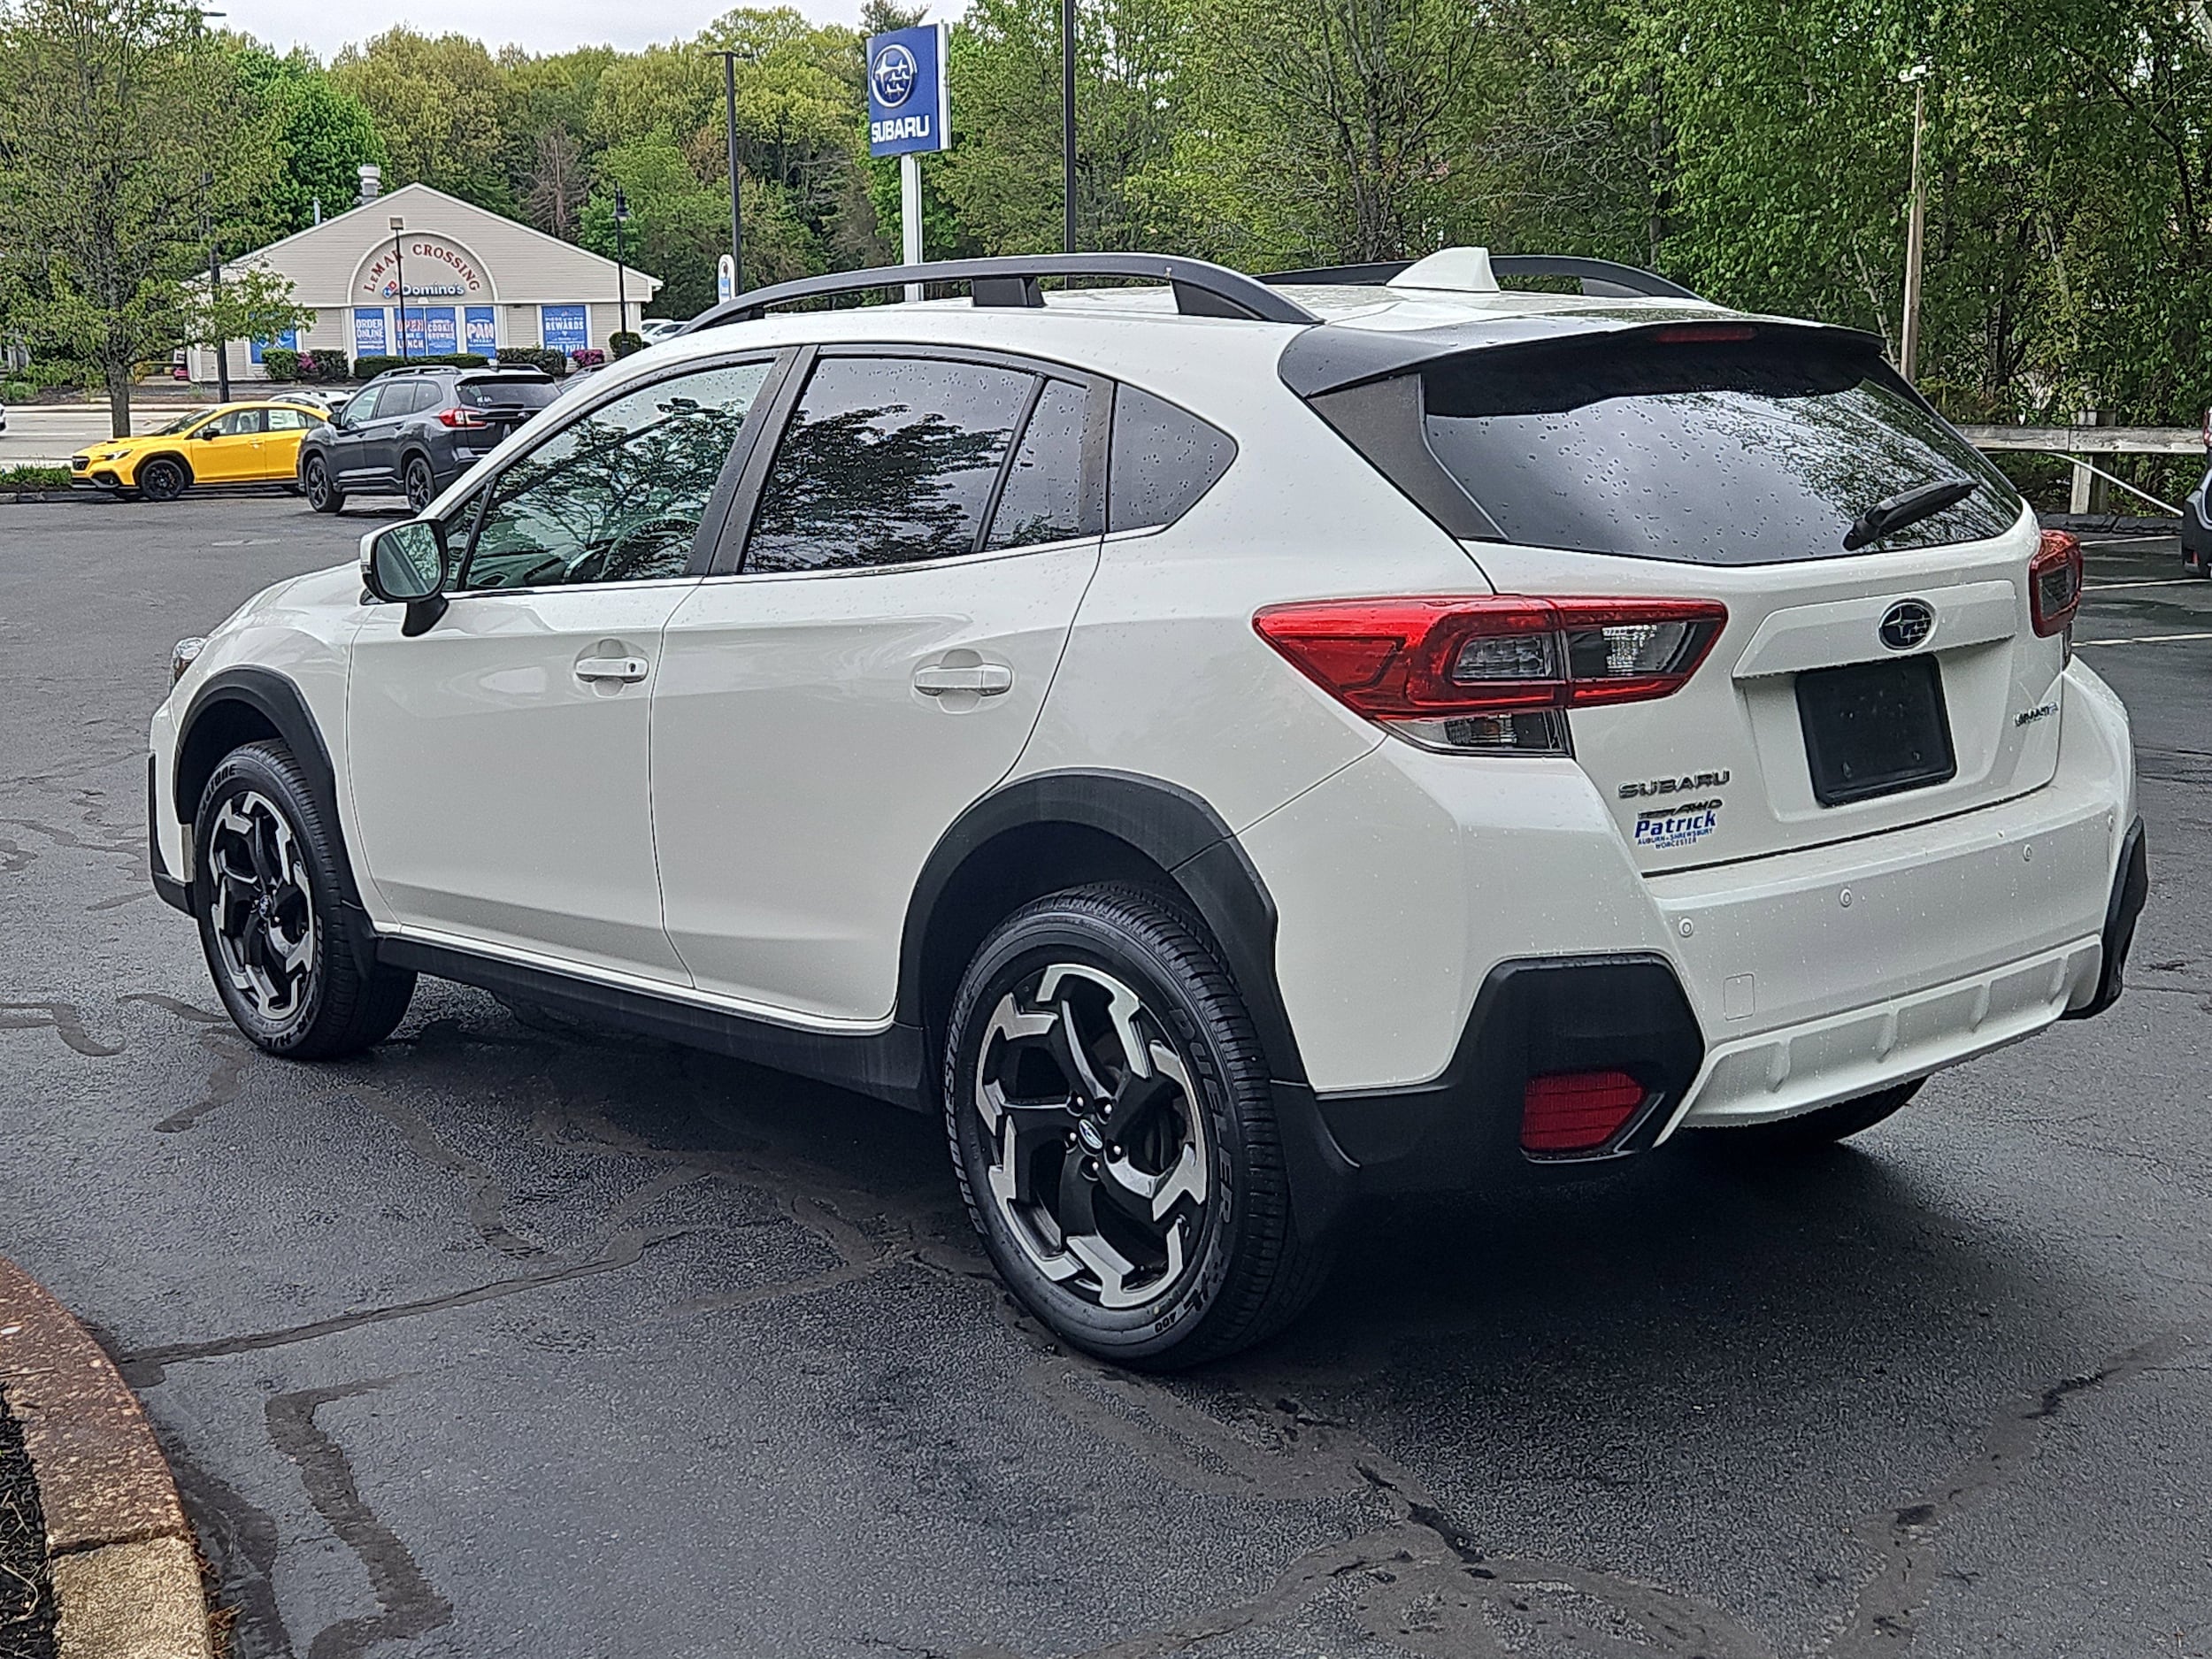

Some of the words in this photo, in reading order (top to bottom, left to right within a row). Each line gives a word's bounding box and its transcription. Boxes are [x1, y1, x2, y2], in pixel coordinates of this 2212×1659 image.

[871, 115, 929, 143] SUBARU
[412, 243, 480, 291] CROSSING
[401, 281, 465, 296] Domino's
[356, 319, 383, 328] ORDER
[357, 328, 384, 338] ONLINE
[466, 323, 495, 339] PAN
[545, 320, 584, 331] REWARDS
[1618, 770, 1731, 799] SUBARU
[1634, 810, 1717, 839] Patrick
[1168, 1007, 1234, 1225] DUELER
